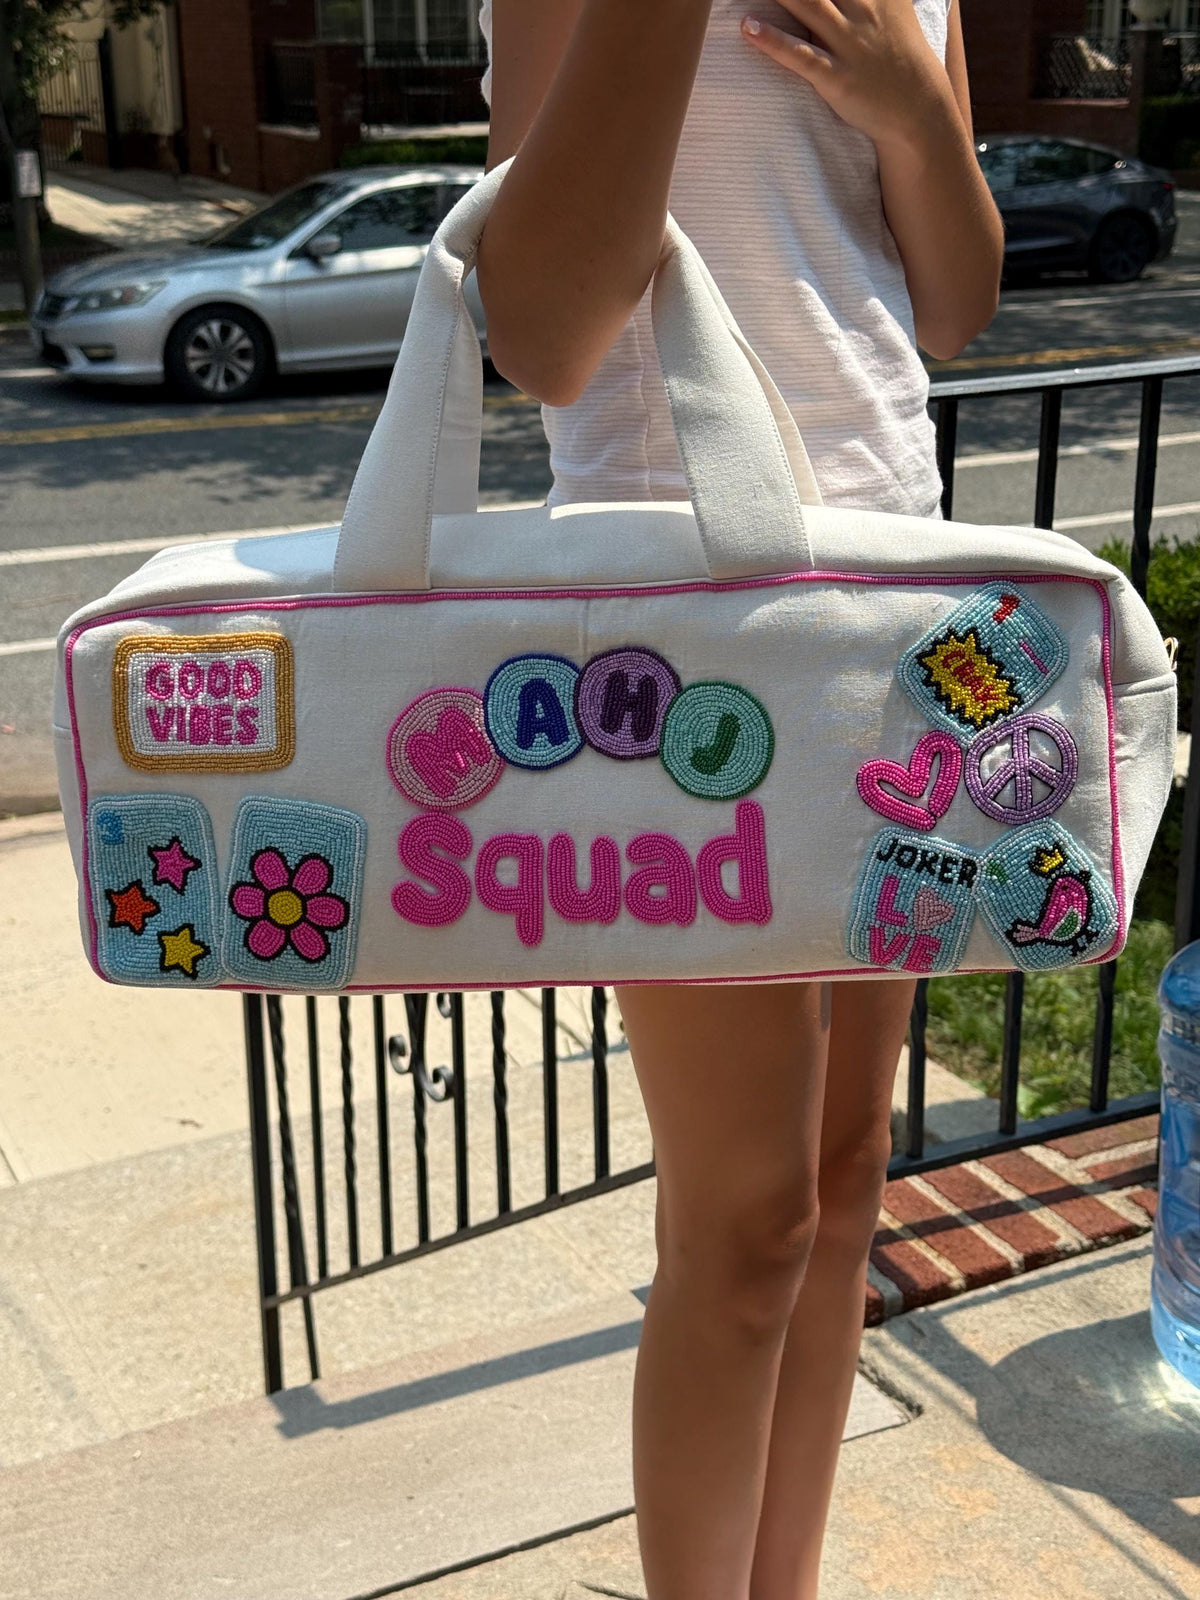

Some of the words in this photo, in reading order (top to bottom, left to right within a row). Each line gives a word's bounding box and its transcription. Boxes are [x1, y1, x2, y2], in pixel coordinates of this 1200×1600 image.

[145, 659, 262, 701] GOOD
[145, 704, 259, 746] VIBES
[391, 800, 773, 947] Squad
[877, 839, 978, 888] JOKER
